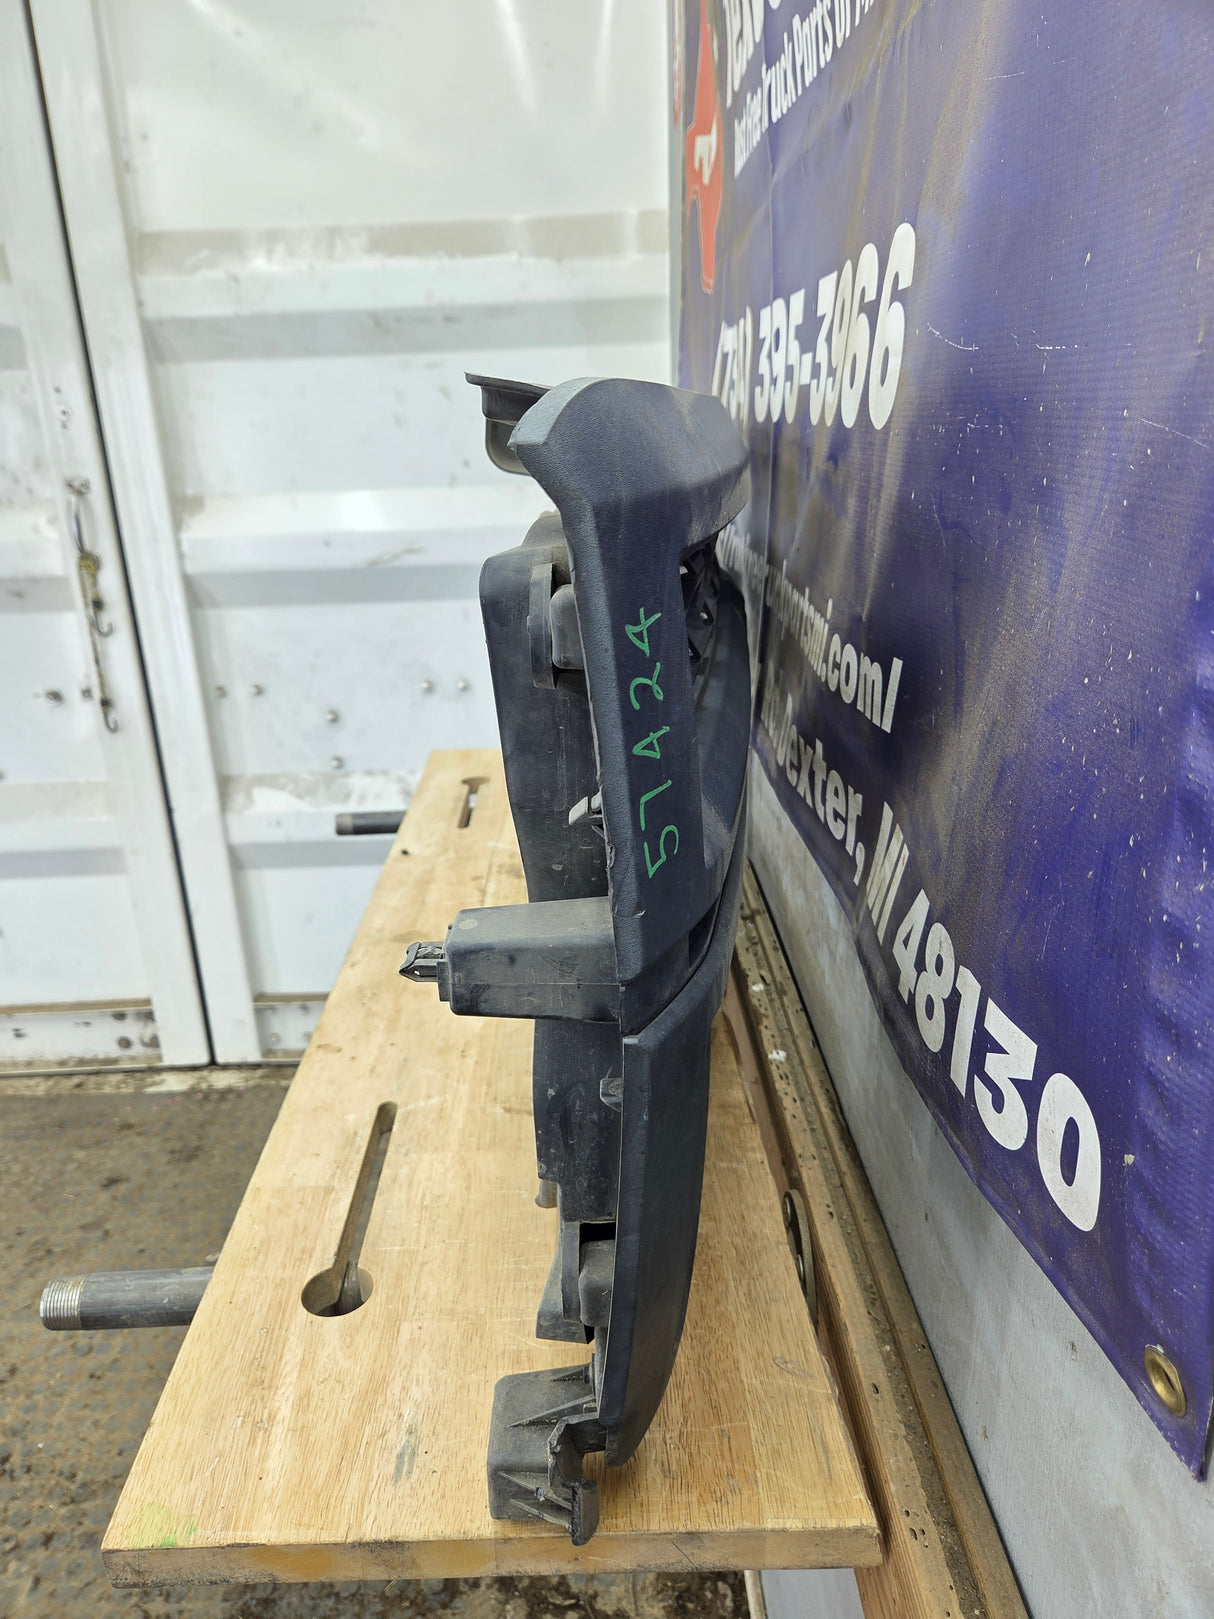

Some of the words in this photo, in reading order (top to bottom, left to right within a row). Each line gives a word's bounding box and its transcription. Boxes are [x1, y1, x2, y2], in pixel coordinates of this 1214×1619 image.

[792, 0, 833, 96] Parts
[754, 222, 916, 430] 395-3966
[776, 691, 866, 886] Dexter,
[866, 801, 909, 946] MI
[892, 889, 1101, 1232] 48130
